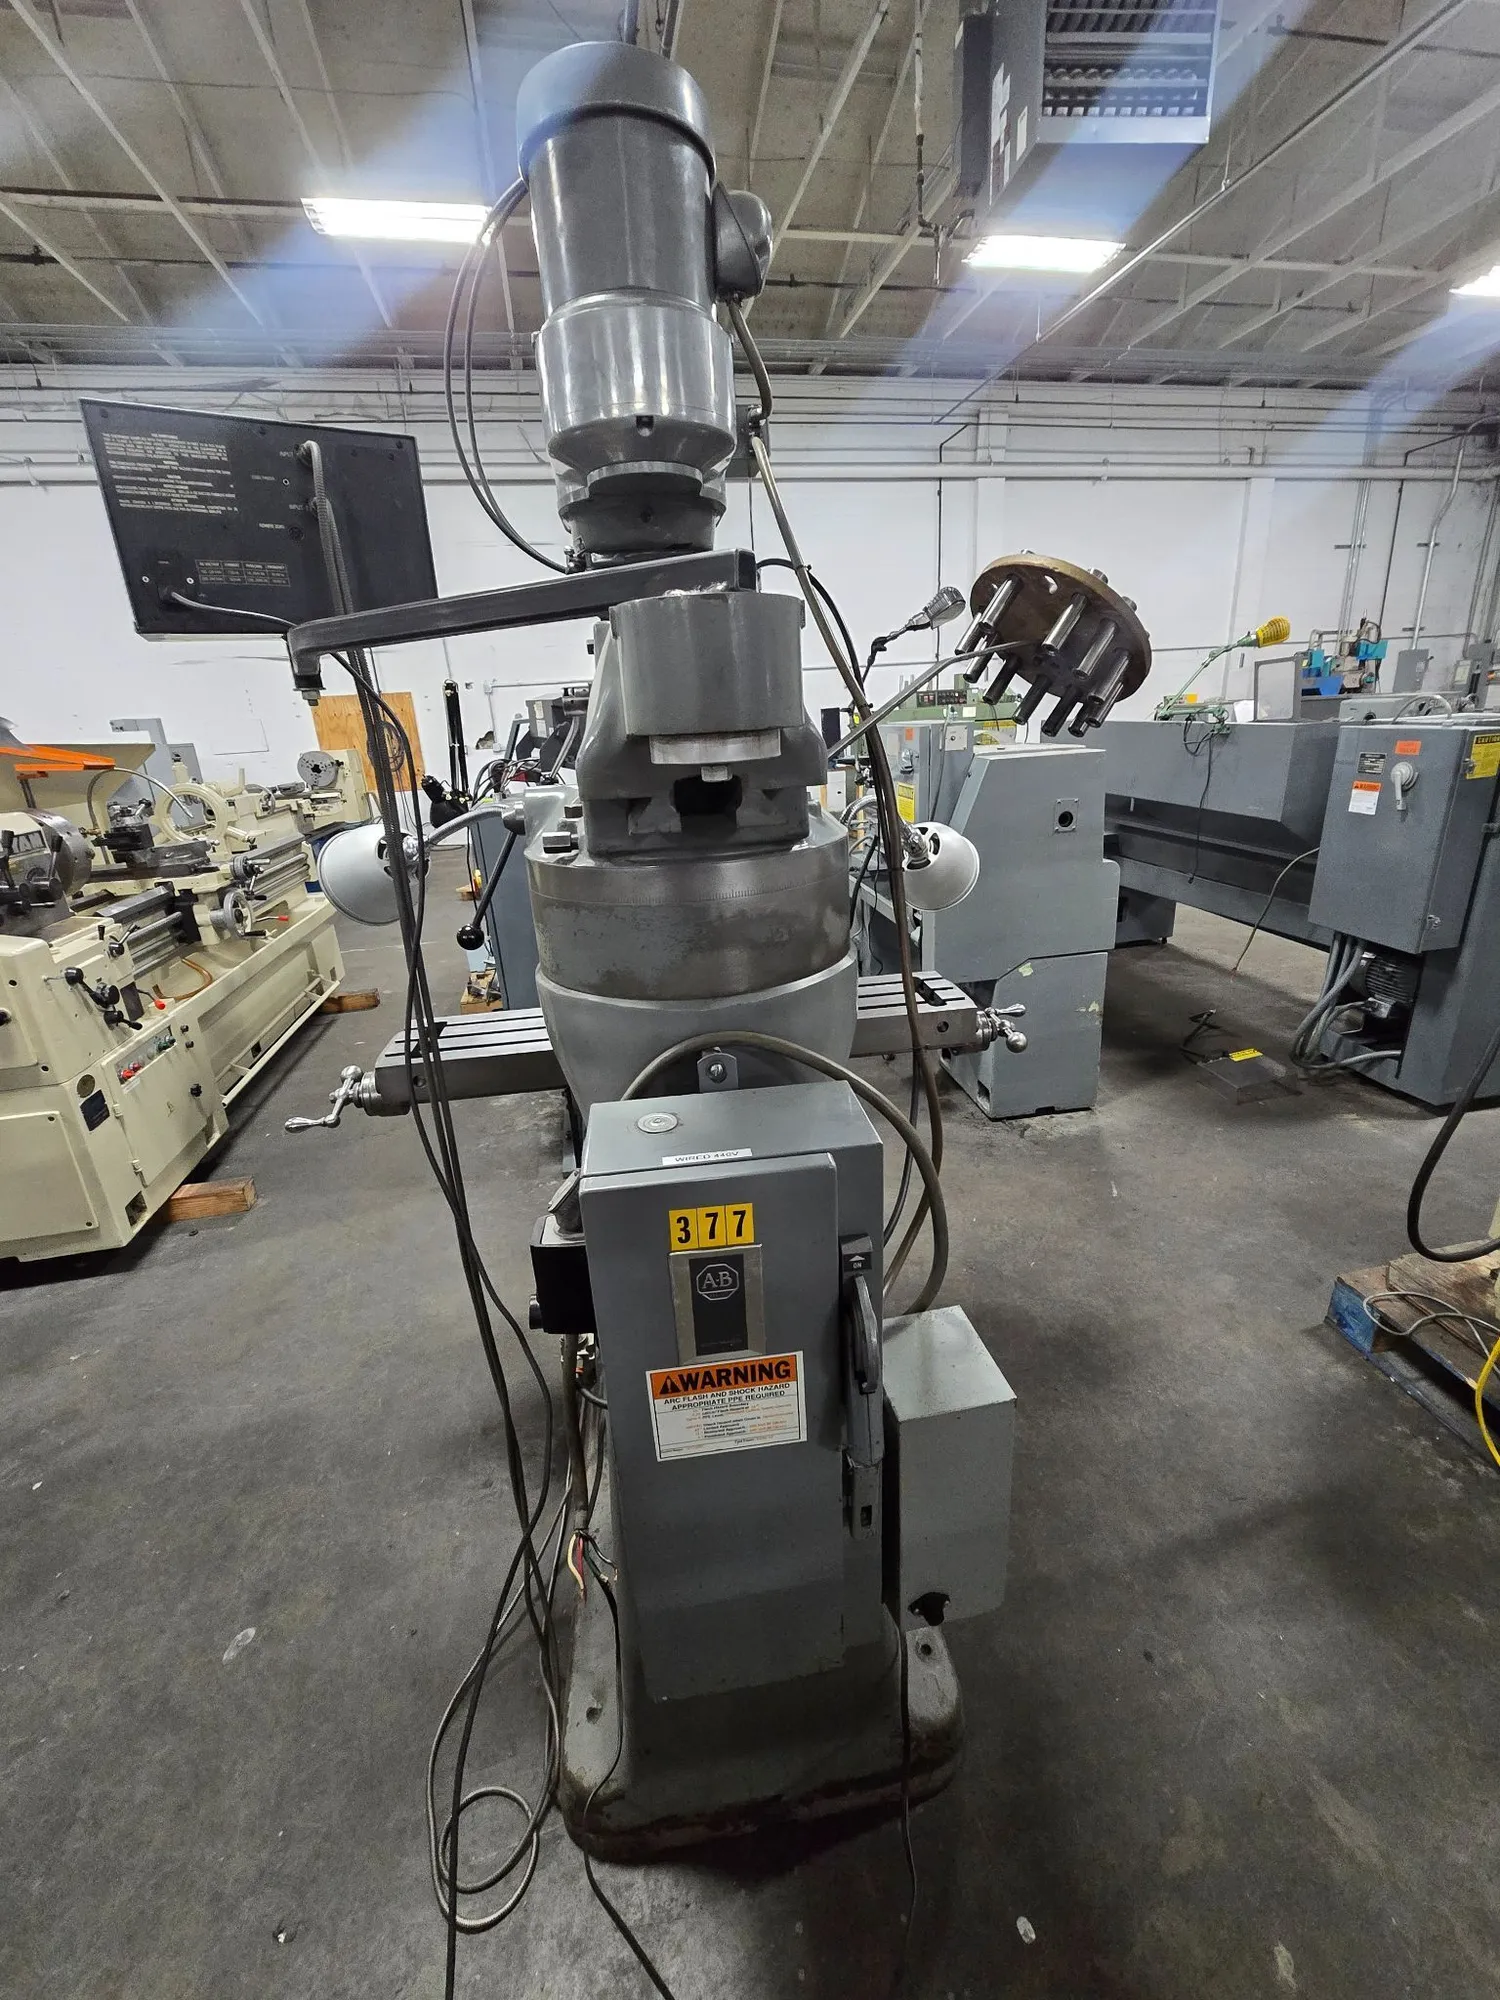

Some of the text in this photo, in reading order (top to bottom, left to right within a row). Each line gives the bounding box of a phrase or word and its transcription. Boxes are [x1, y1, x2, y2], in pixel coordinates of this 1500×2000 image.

[675, 1154, 711, 1162] WIRED
[678, 1360, 791, 1392] WARNING
[664, 1383, 790, 1405] ARC FLASH AND SHOCK HAZARD
[672, 1398, 726, 1411] APPROPRIATE
[745, 1390, 785, 1401] REQUIRED
